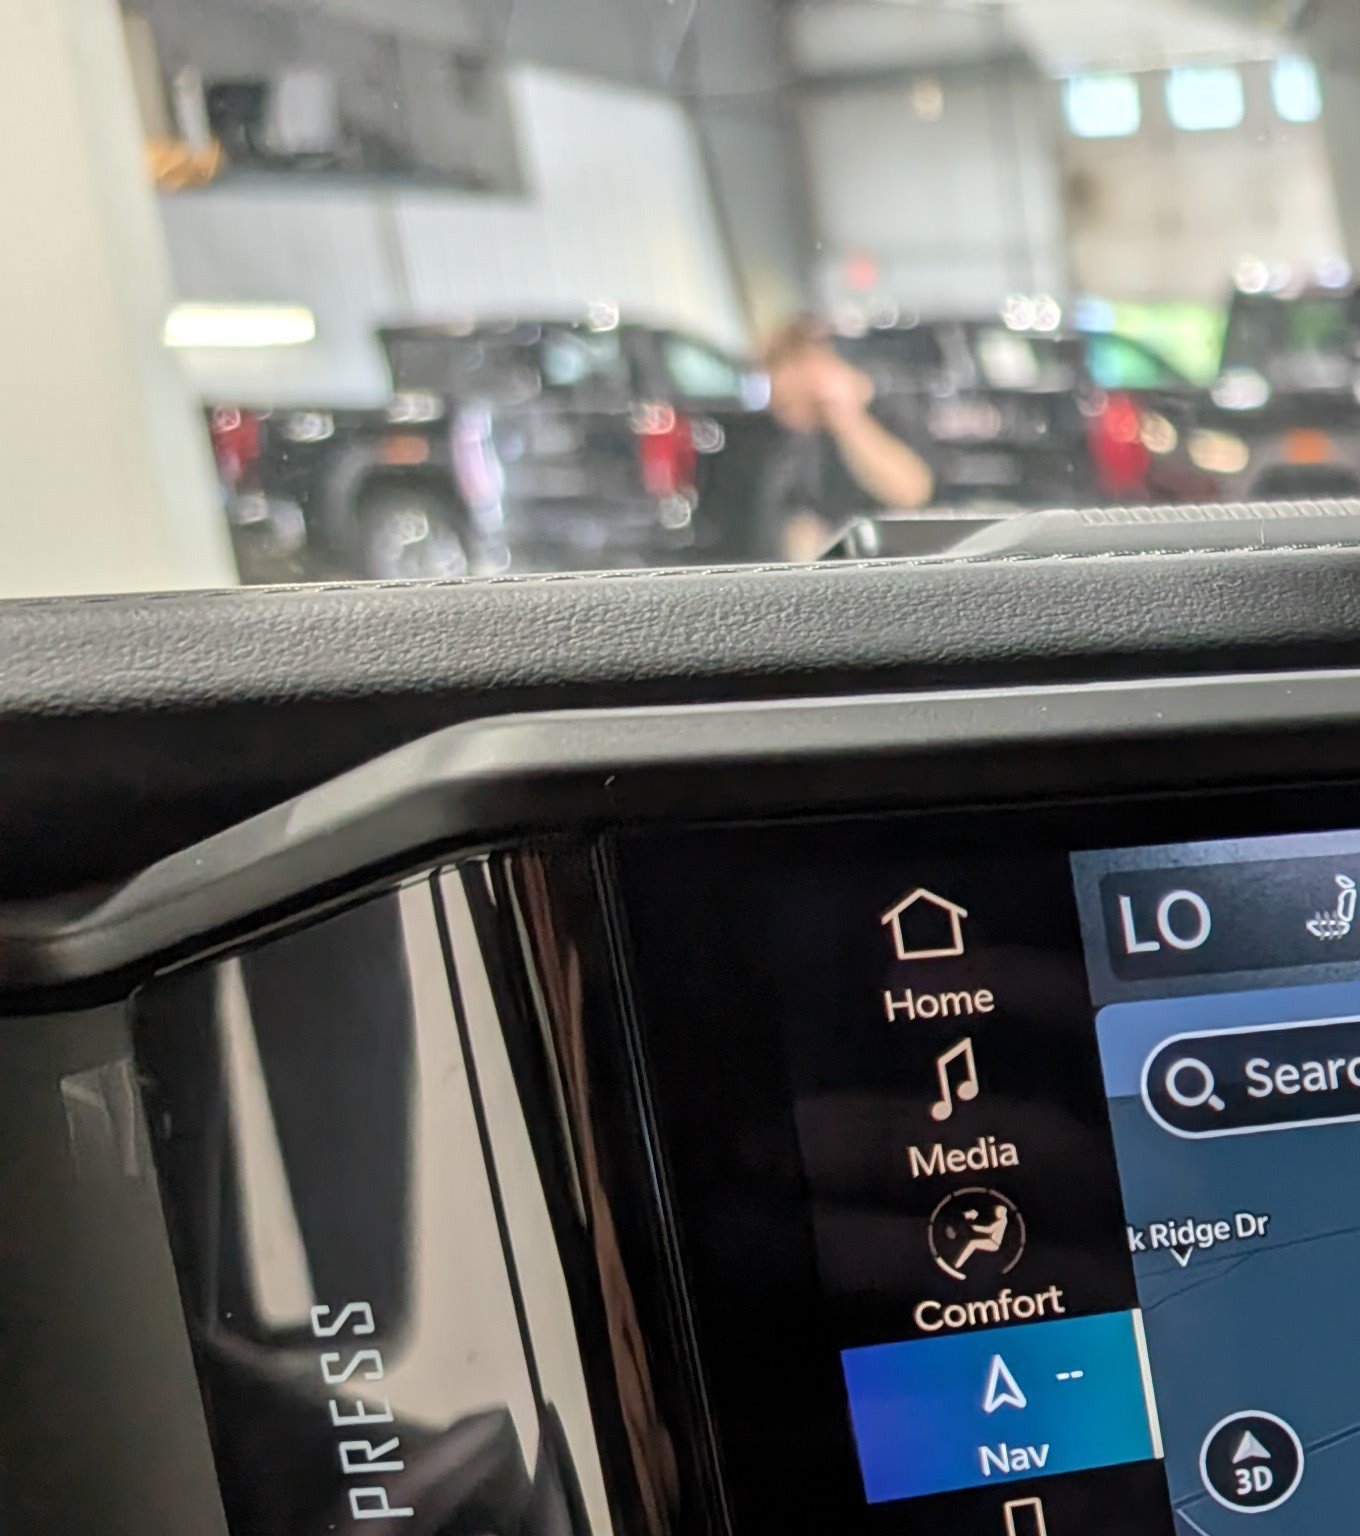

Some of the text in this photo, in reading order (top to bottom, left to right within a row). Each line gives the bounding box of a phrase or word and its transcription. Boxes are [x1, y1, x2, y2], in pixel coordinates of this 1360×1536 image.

[1118, 888, 1212, 955] LO
[884, 987, 995, 1022] Home
[907, 1137, 1020, 1178] Media
[1150, 1217, 1230, 1249] Ridge
[1235, 1212, 1269, 1238] Dr
[914, 1284, 1066, 1333] Comfort
[310, 1300, 414, 1519] PRESS
[979, 1442, 1050, 1478] Nav
[1234, 1466, 1274, 1495] 3D
